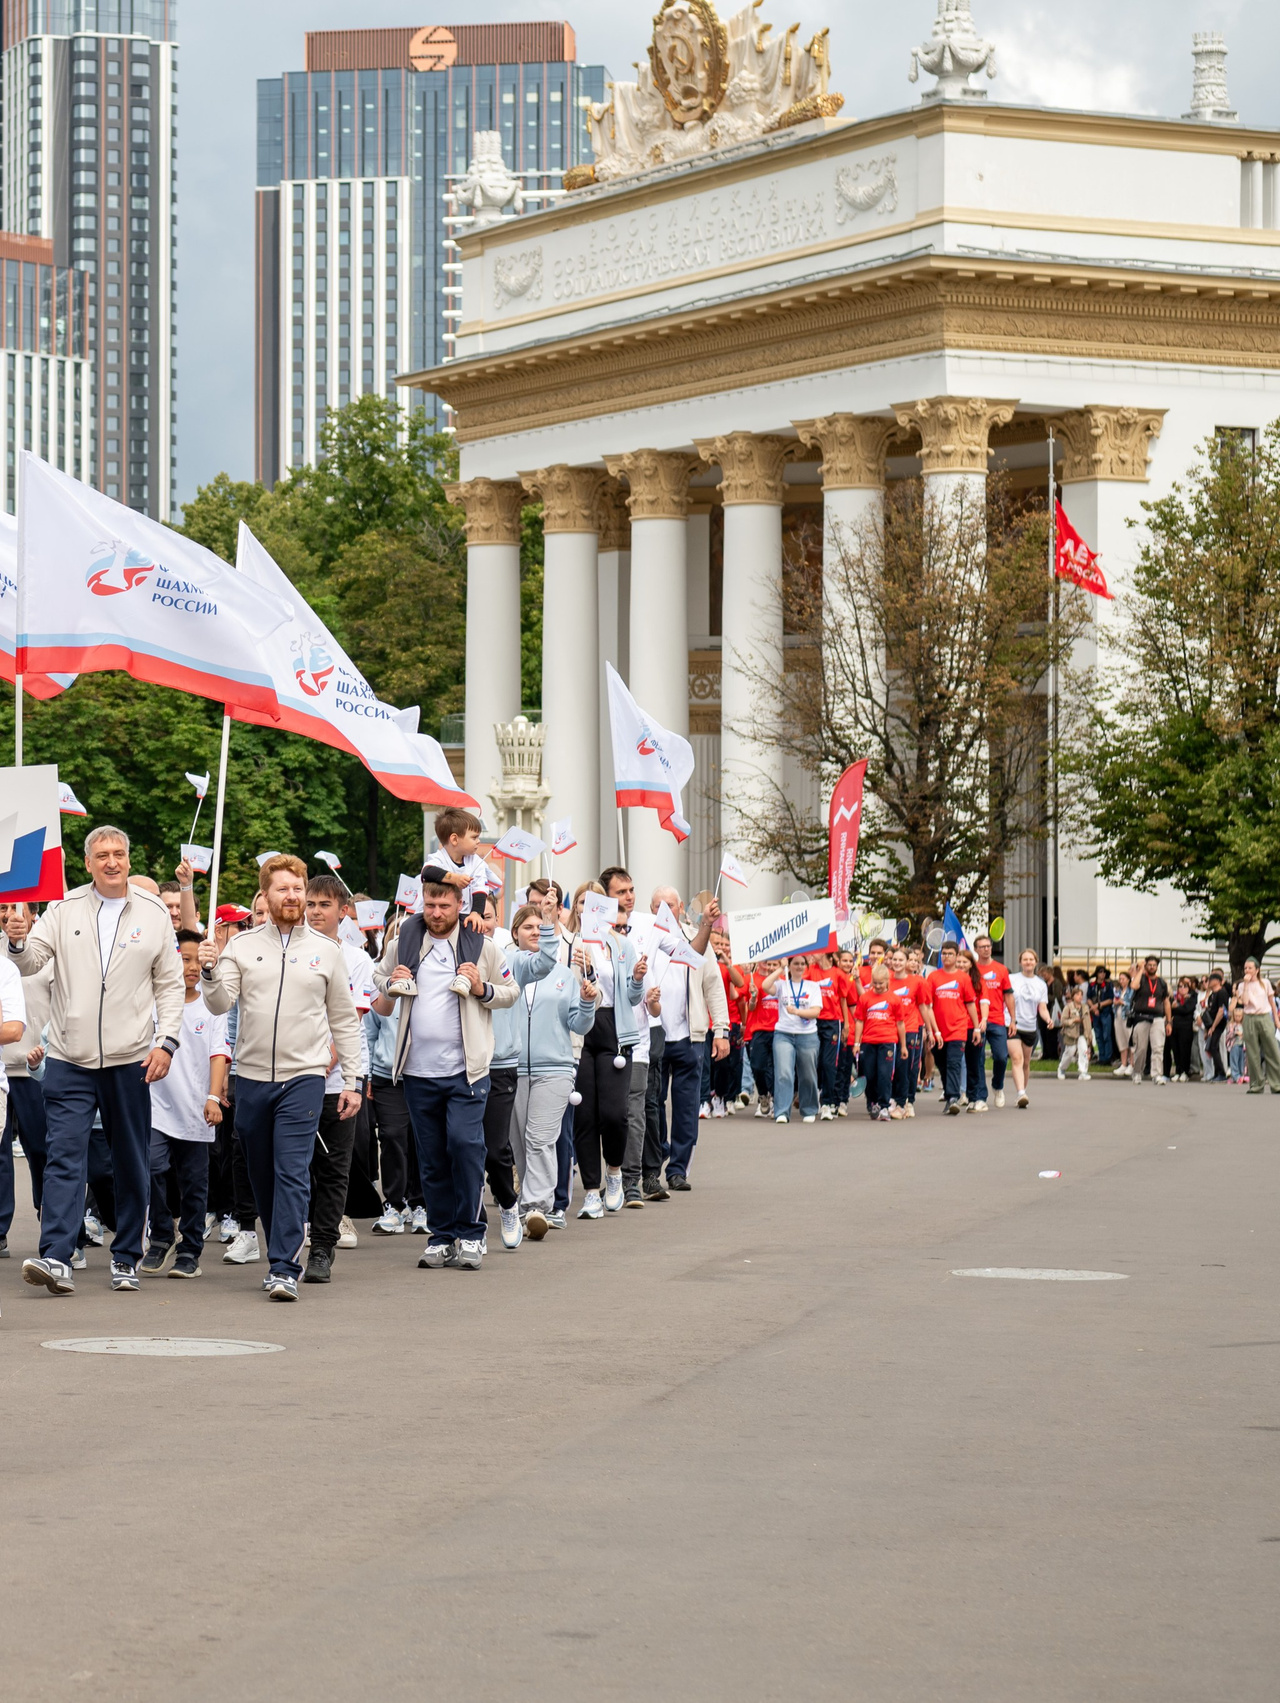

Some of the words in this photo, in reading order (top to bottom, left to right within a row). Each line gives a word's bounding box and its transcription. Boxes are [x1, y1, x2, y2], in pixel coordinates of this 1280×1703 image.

[552, 244, 711, 300] СОЦИАЛИСТИЧЕСКАЯ
[719, 217, 827, 262] РЕСПУБЛИКА
[553, 234, 657, 278] СОВЕТСКАЯ
[668, 191, 824, 249] ФЕДЕРАТИВНАЯ
[152, 592, 218, 615] РОССИИ
[156, 577, 209, 596] ШАХМ
[748, 909, 809, 960] БАДМИНТОН
